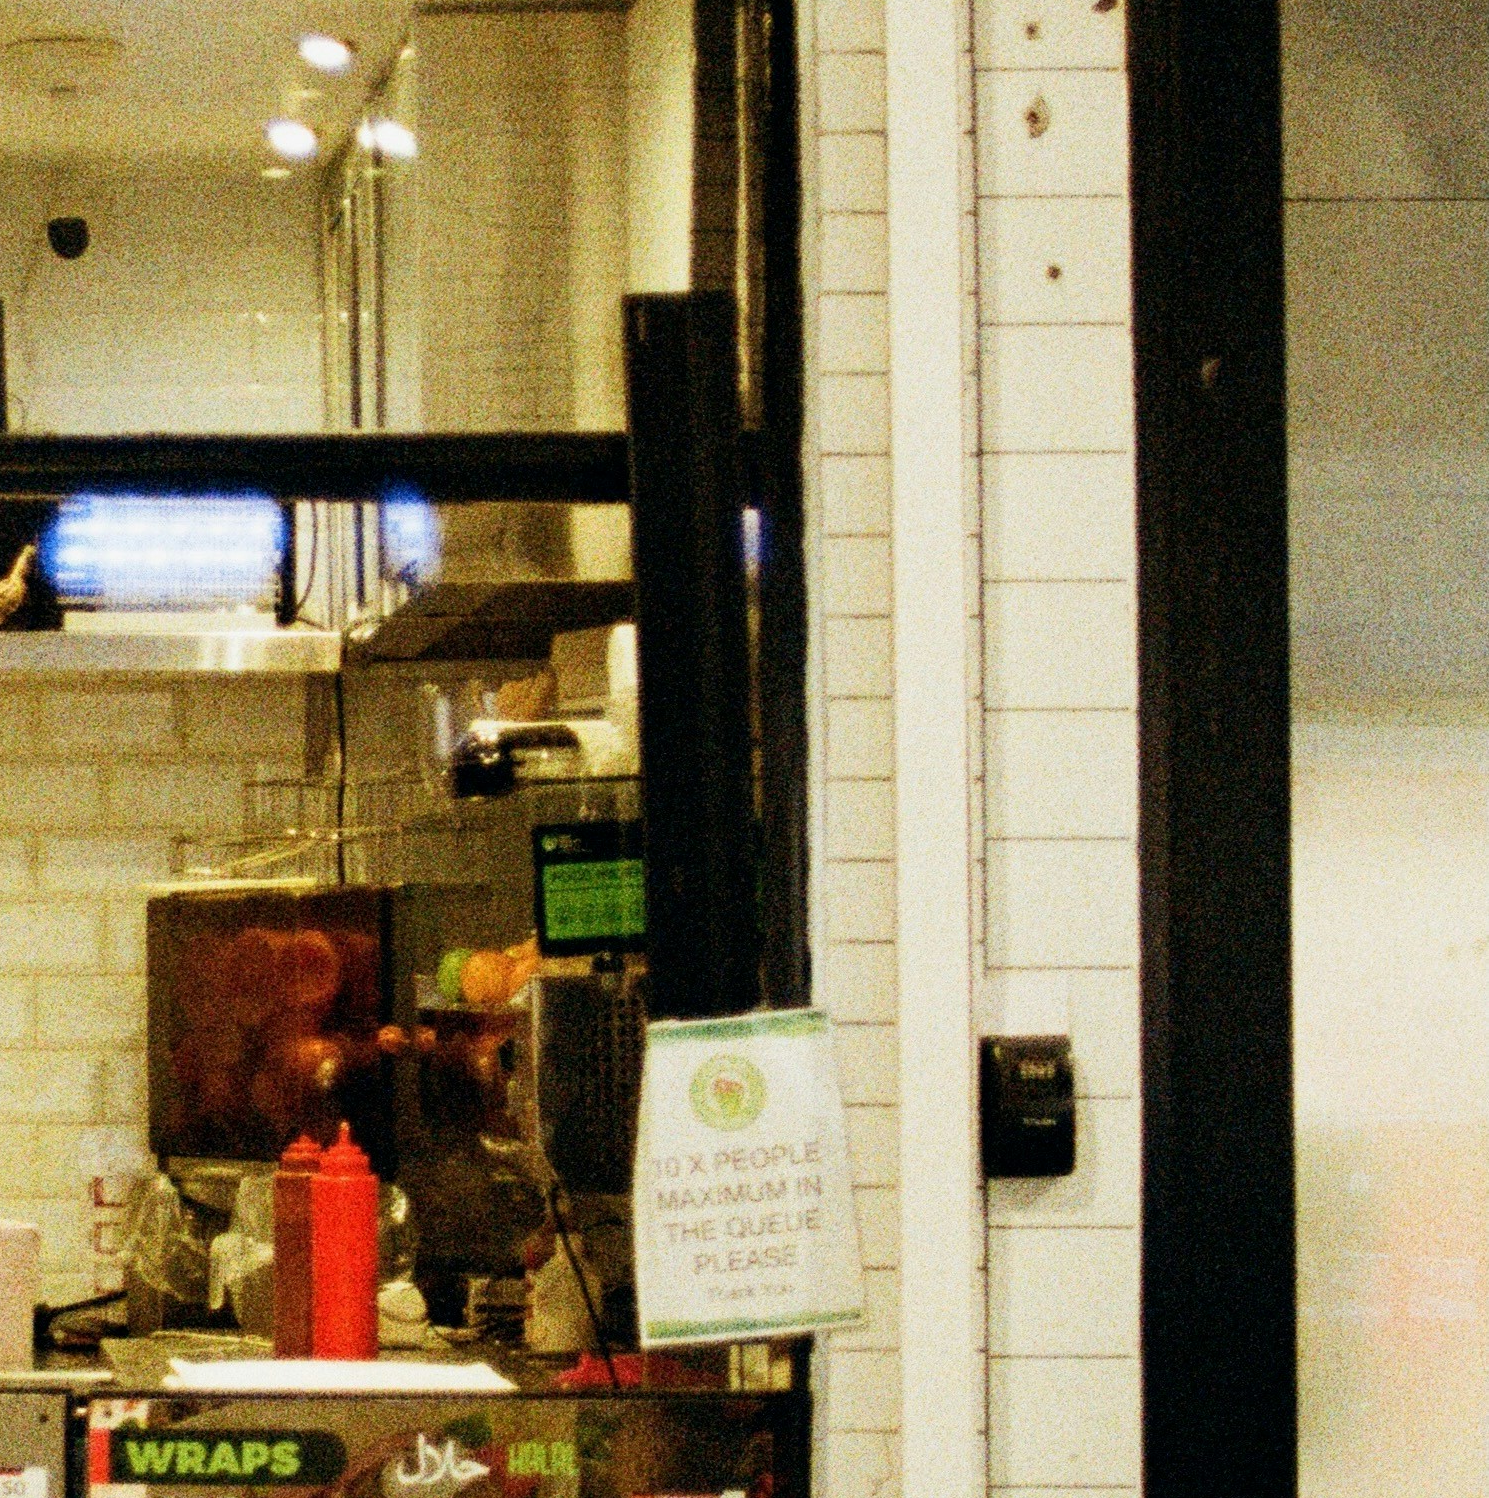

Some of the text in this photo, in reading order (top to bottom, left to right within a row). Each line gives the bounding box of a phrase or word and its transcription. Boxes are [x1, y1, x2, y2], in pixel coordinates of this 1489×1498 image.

[713, 1141, 821, 1171] PEOPLE
[657, 1176, 822, 1210] MAXIMUM IN
[664, 1208, 821, 1243] THE QUEUE
[693, 1244, 798, 1275] PLEASE
[123, 1441, 302, 1477] WRAPS
